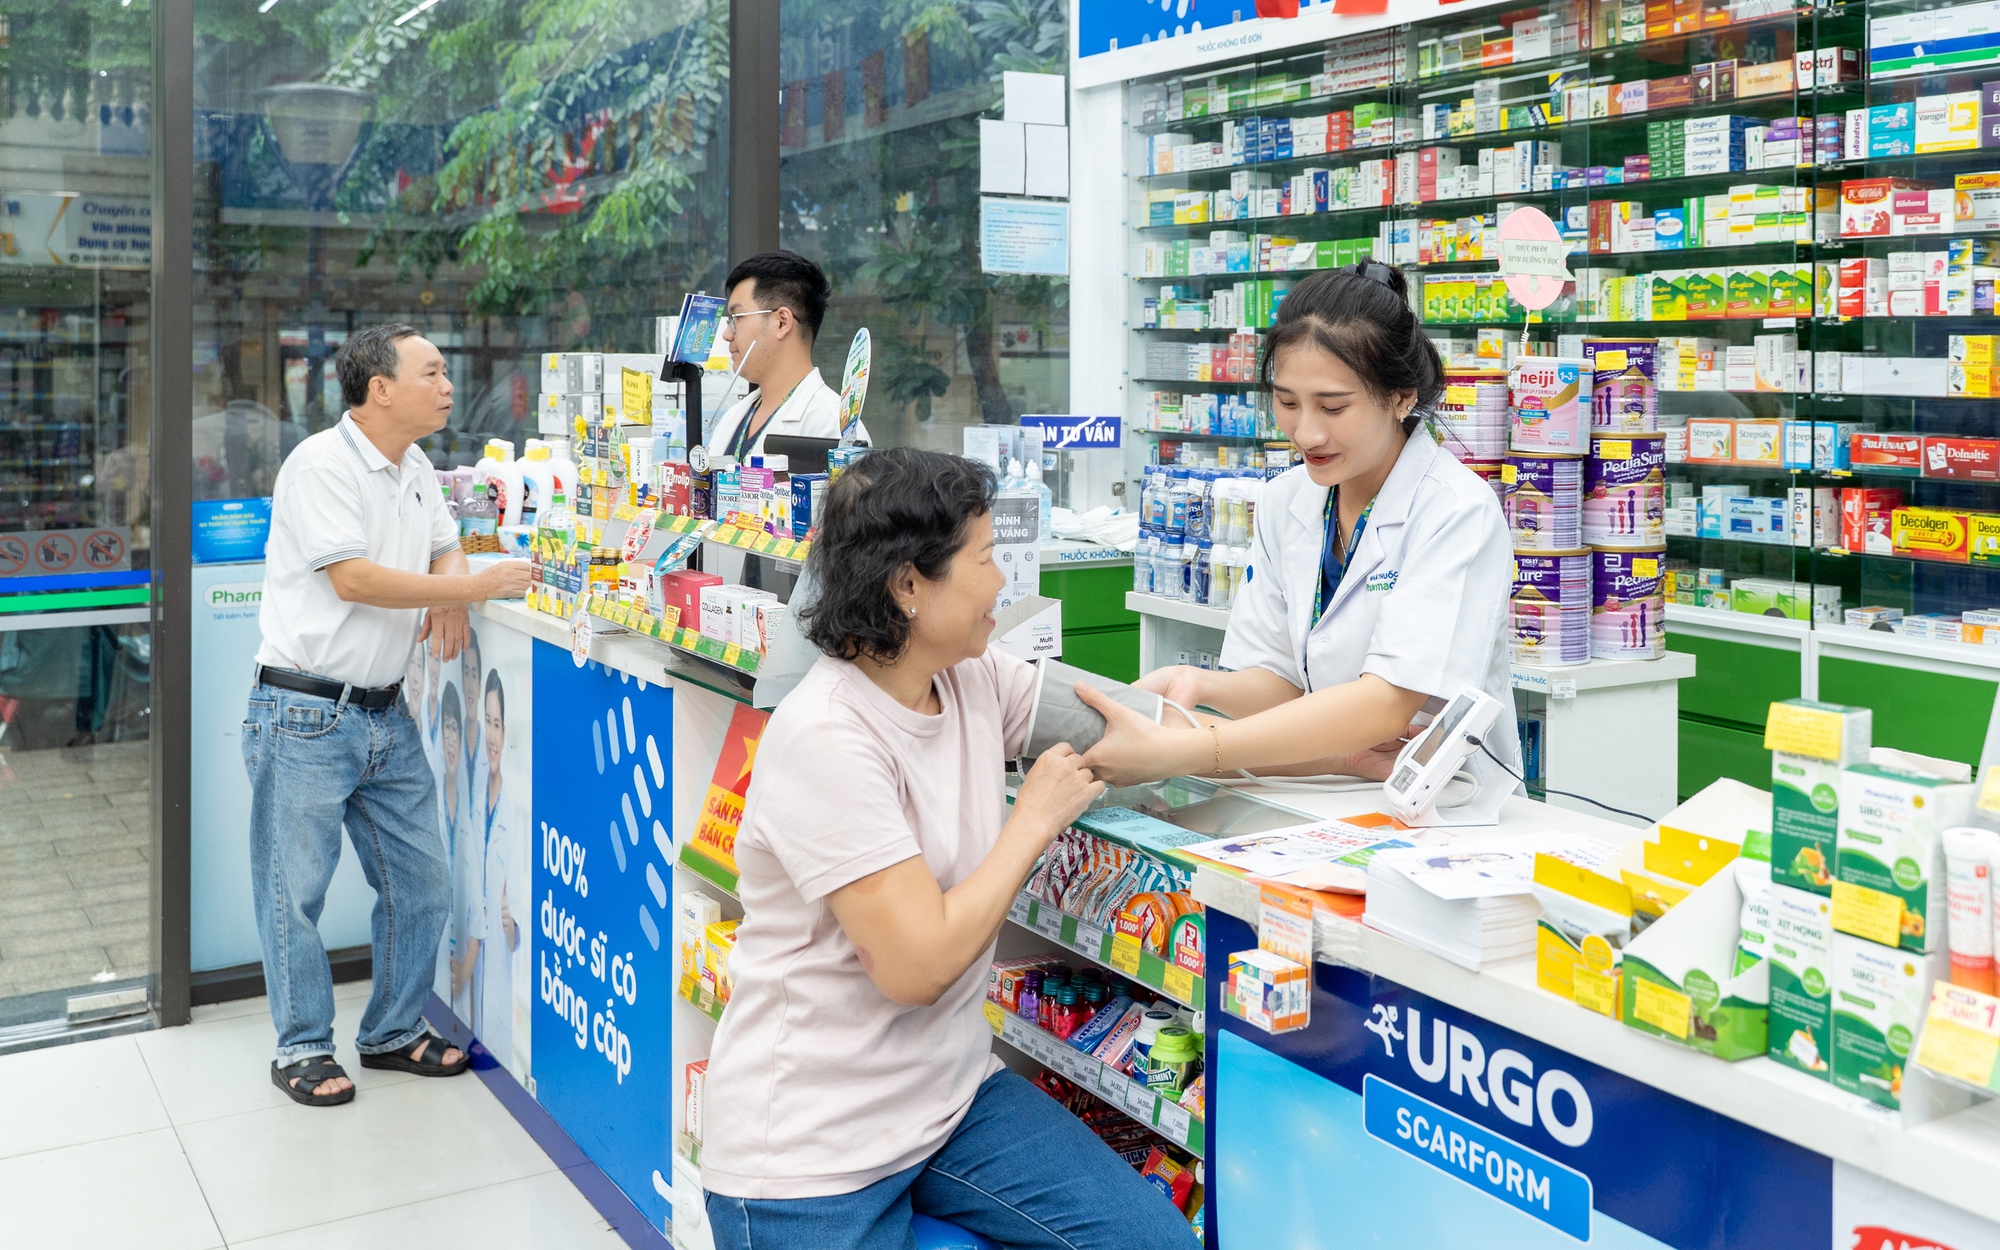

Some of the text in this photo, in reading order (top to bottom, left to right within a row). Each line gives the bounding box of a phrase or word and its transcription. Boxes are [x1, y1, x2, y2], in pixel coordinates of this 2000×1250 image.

[1918, 111, 1947, 122] Varogel
[1853, 114, 1862, 157] Suspengel
[1518, 370, 1555, 389] meiji
[1039, 421, 1058, 442] ÀN
[1084, 420, 1115, 442] VẤN
[1692, 428, 1724, 440] Strepsils
[1738, 429, 1772, 440] Strepsils
[1947, 447, 1990, 460] Dolnaltic
[1602, 451, 1664, 477] PediaSure
[664, 469, 690, 489] Ferrolip
[774, 486, 791, 498] Optibac
[1900, 513, 1949, 532] Decolgen
[1001, 527, 1029, 538] VÁNG
[1060, 548, 1119, 561] THUỐC KHÔNG
[701, 601, 723, 616] COLLAGEN
[1032, 643, 1054, 652] Vitamin
[1039, 636, 1054, 644] Multi
[1530, 676, 1547, 686] THUỐC
[707, 793, 730, 822] SẢN
[698, 820, 723, 849] BÁN
[541, 820, 589, 899] 100%
[541, 888, 637, 1006] dược sĩ có
[541, 950, 632, 1085] bằng cấp
[1077, 999, 1120, 1042] mentos
[1097, 1020, 1130, 1059] mentos
[1407, 1006, 1594, 1148] URGO
[1395, 1106, 1550, 1212] SCARFORM
